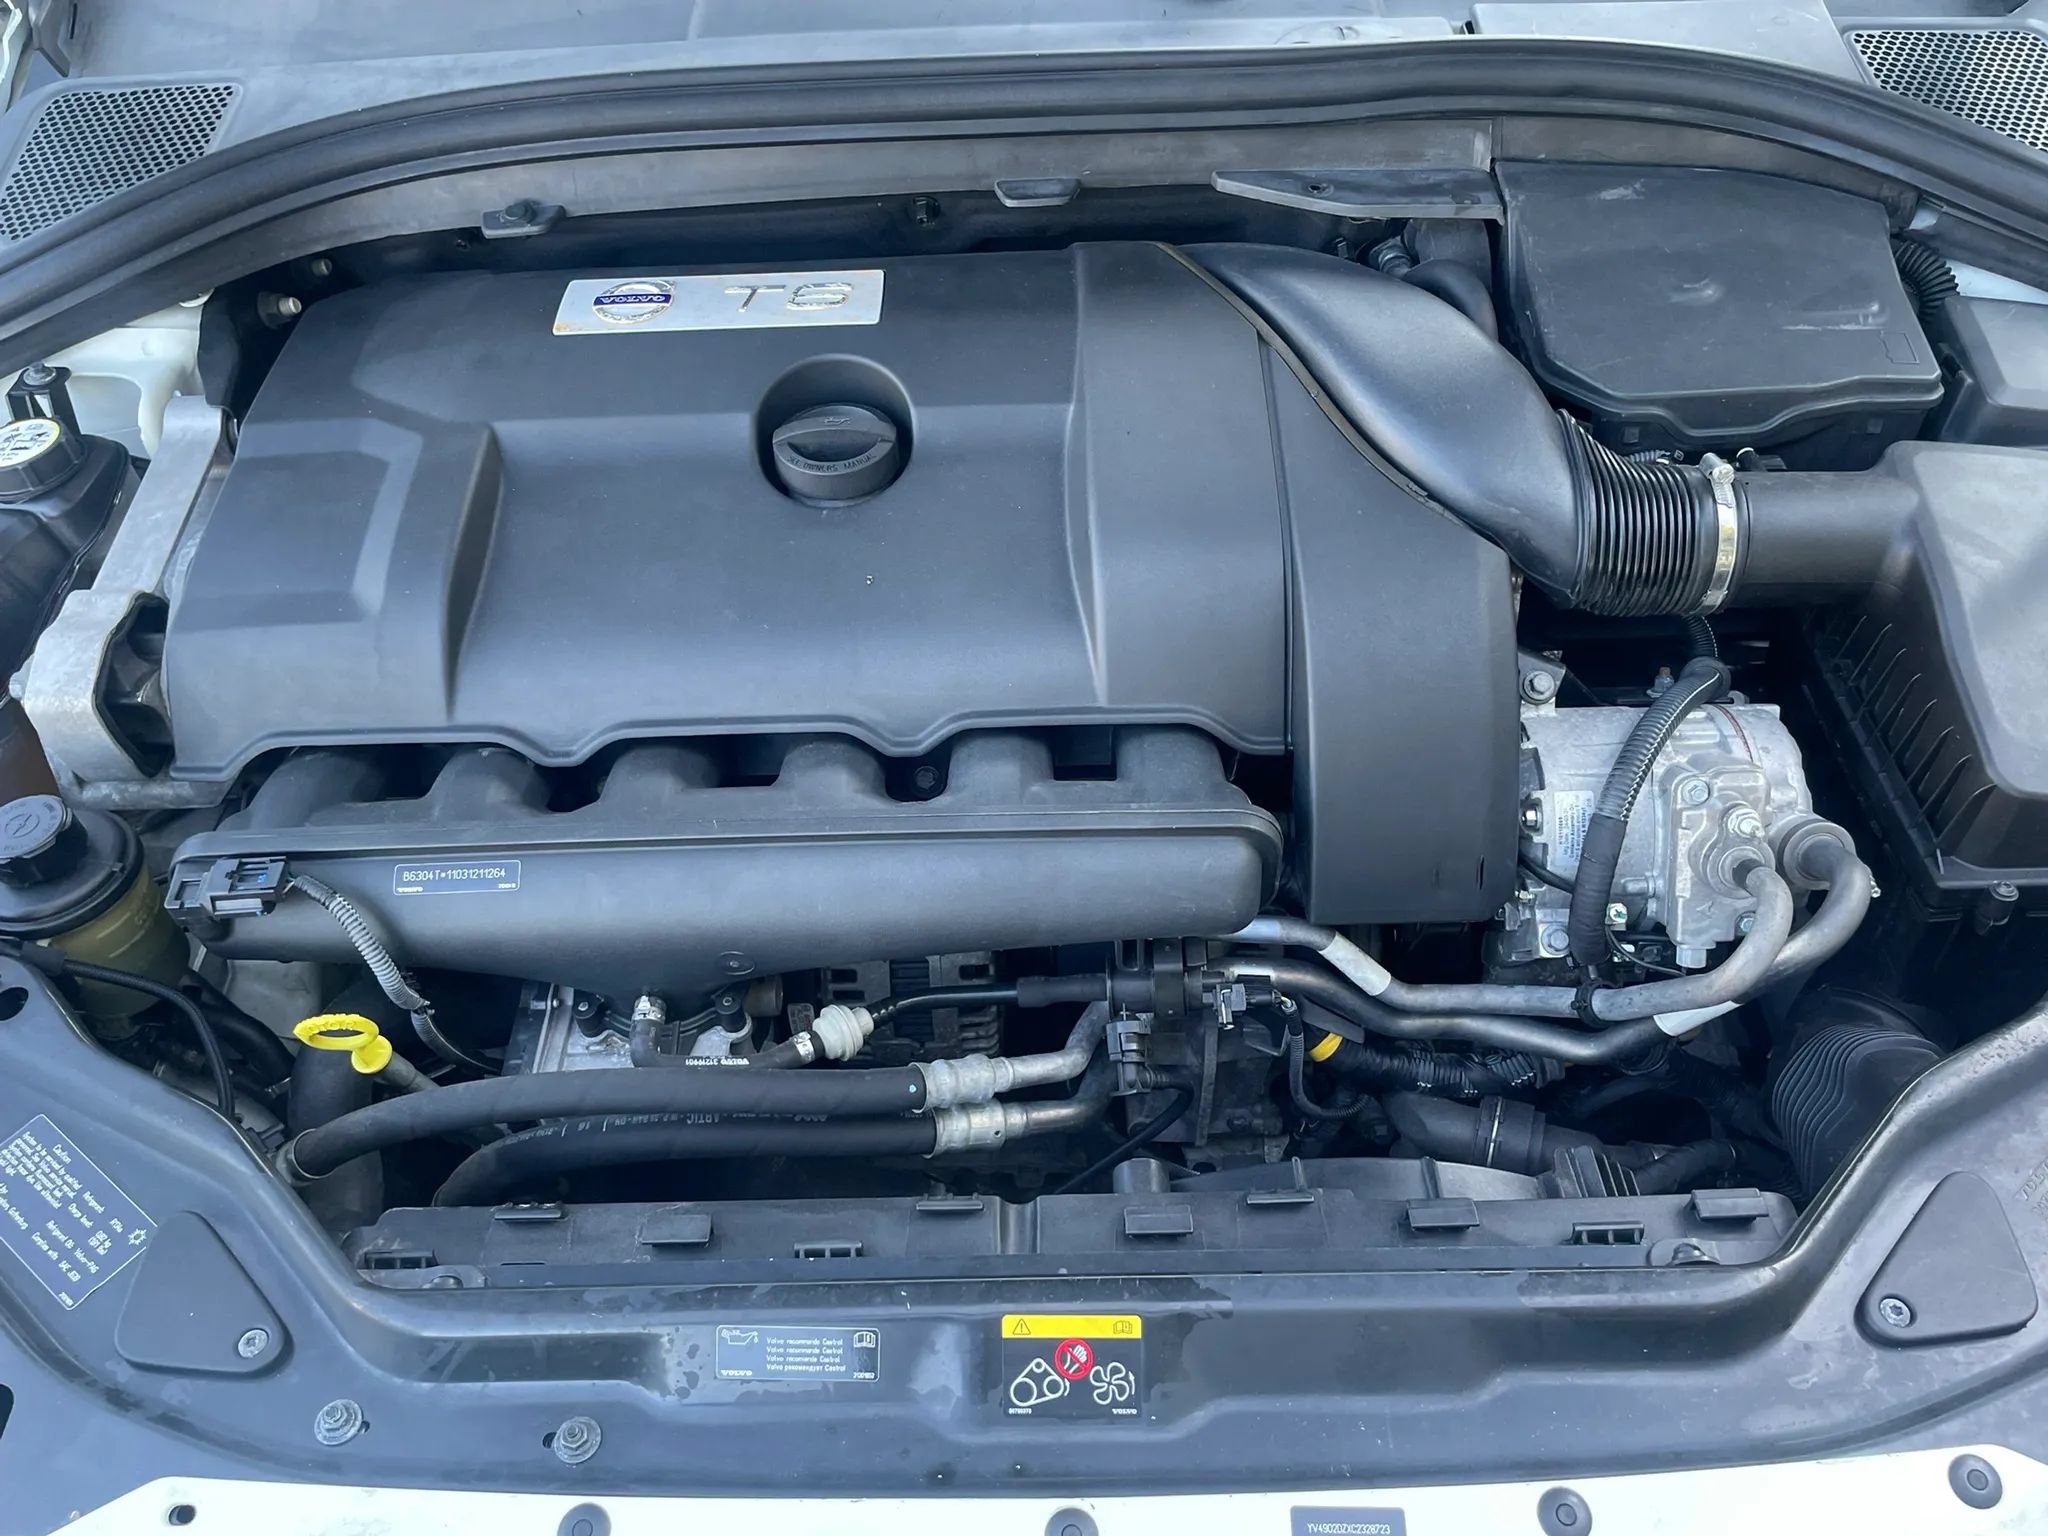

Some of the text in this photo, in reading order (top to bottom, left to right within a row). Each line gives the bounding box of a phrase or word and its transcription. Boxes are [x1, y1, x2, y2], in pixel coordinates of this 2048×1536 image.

[600, 294, 666, 305] VOLVO
[724, 282, 853, 313] T6
[822, 1338, 843, 1346] Castrol
[824, 1364, 846, 1372] Castrol
